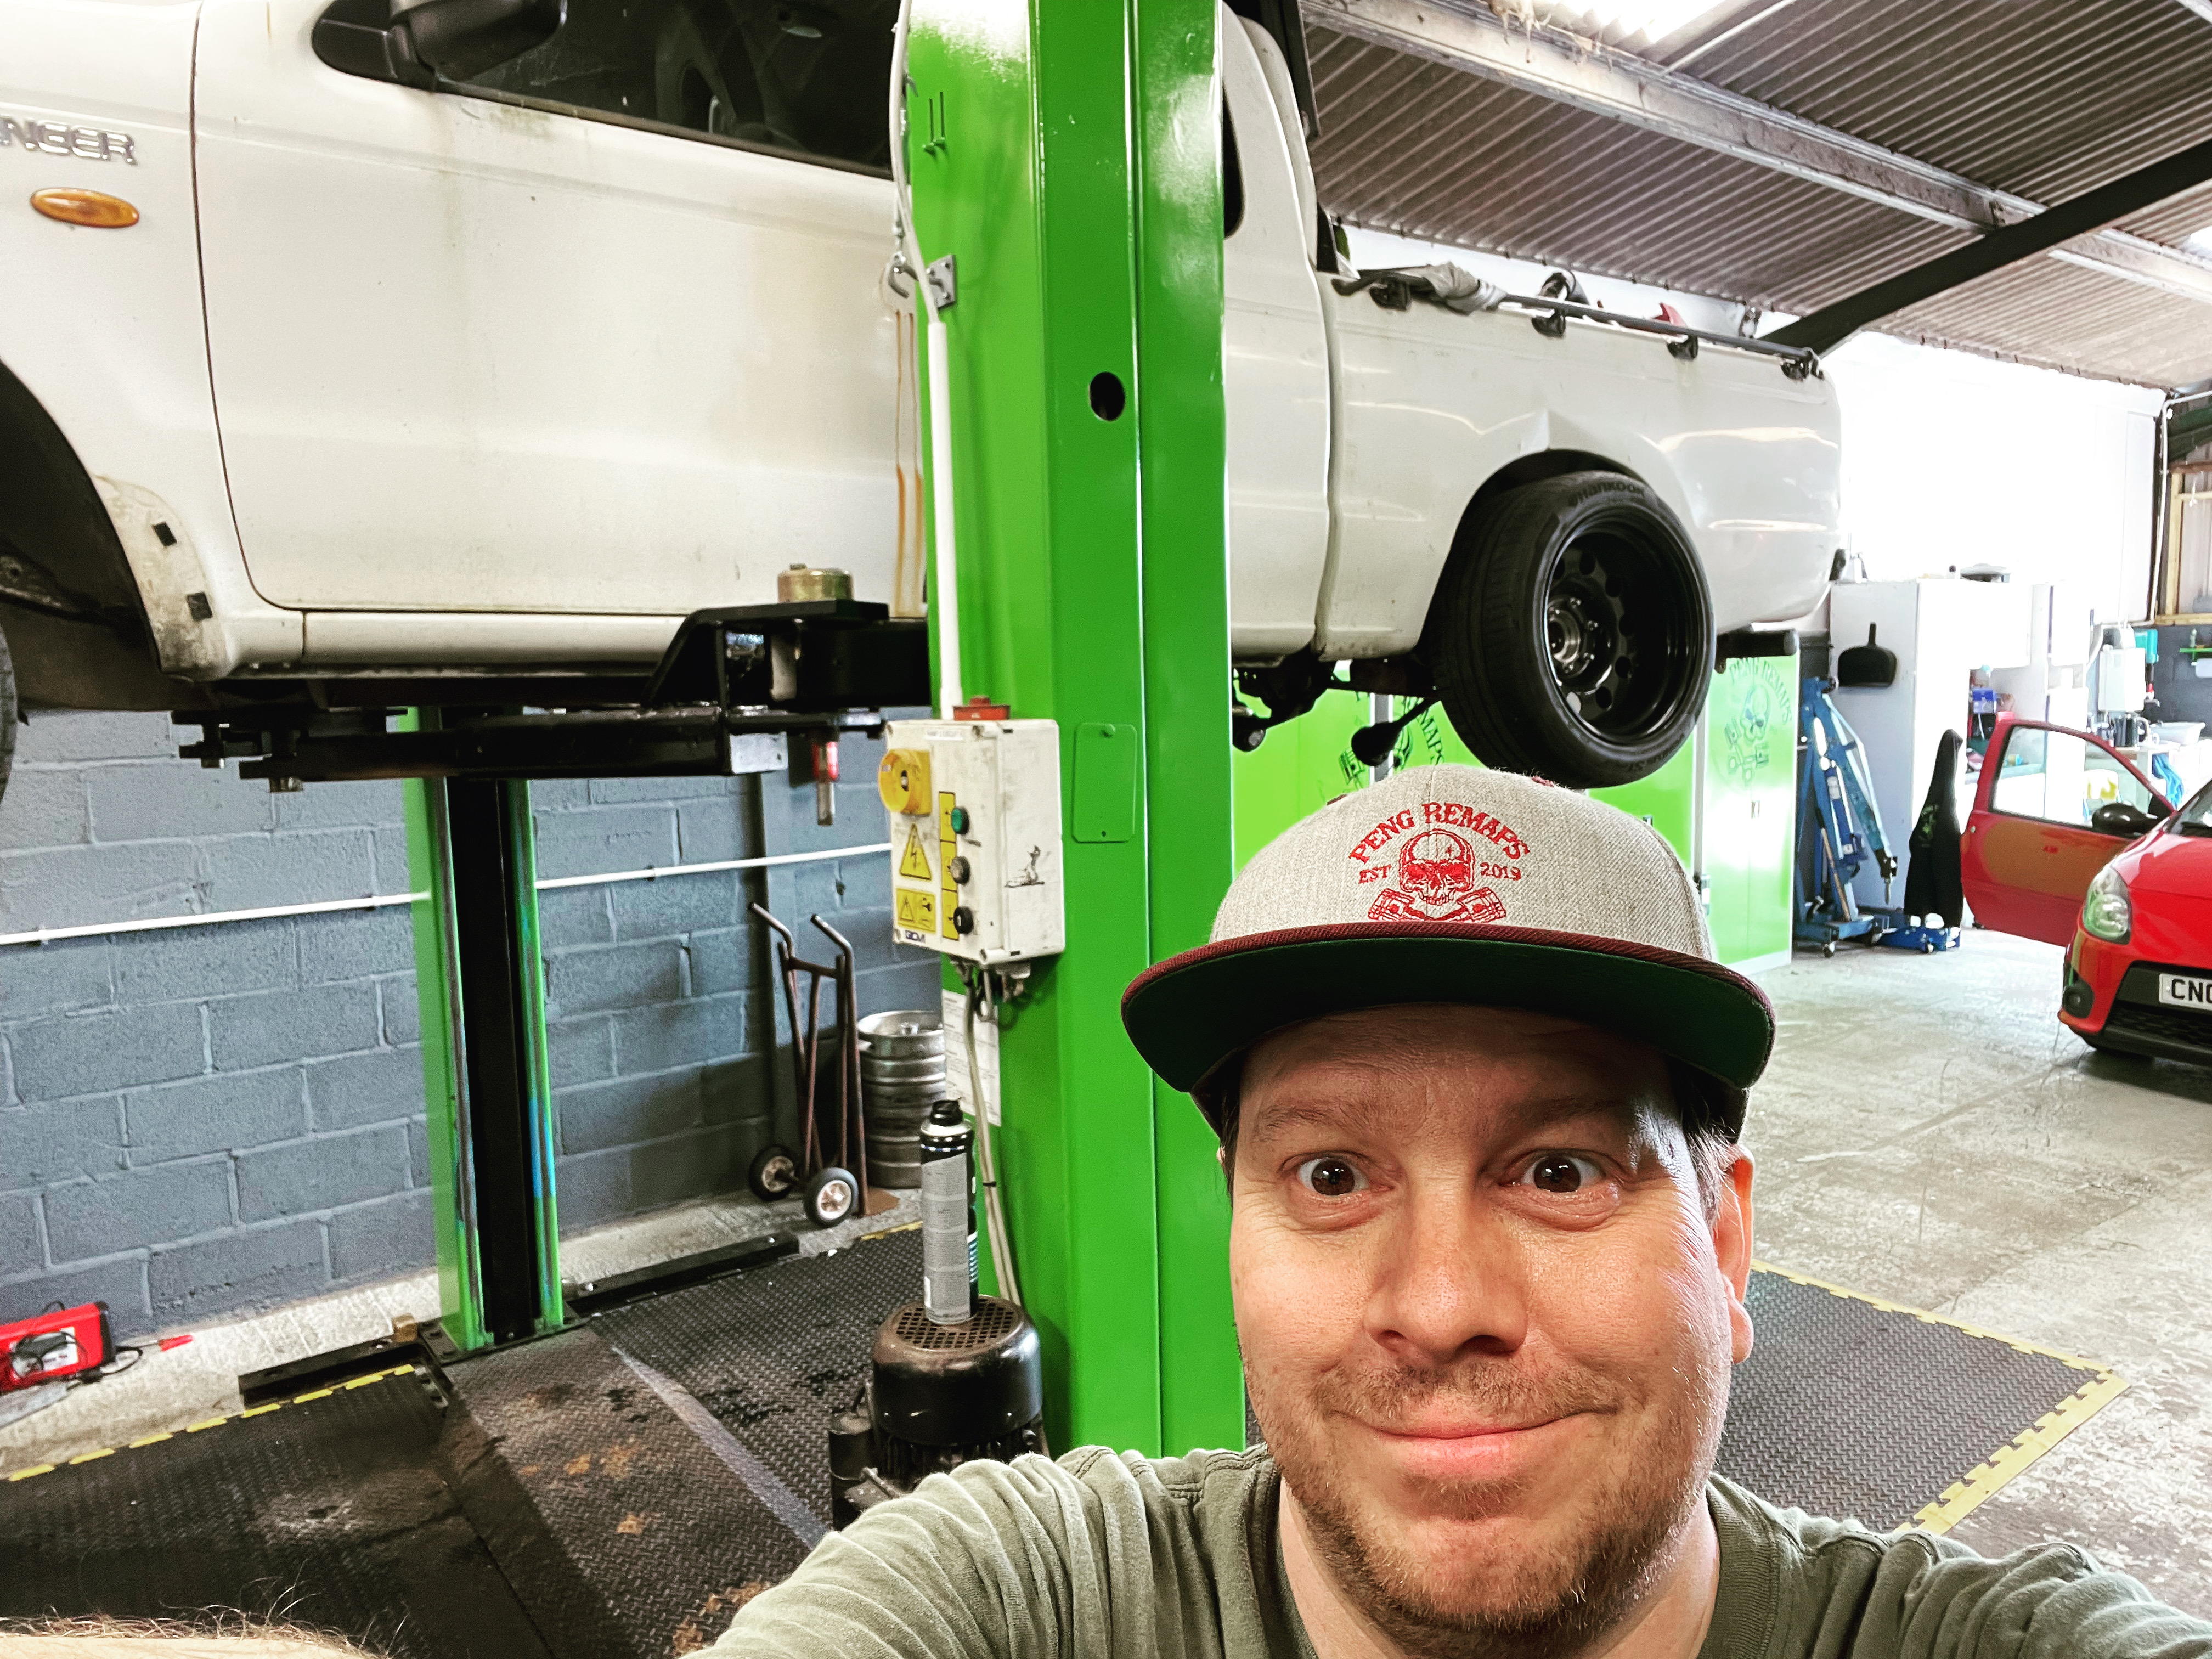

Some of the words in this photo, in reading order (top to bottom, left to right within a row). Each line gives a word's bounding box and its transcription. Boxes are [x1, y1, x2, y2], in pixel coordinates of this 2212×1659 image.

[1348, 809, 1415, 864] PENG
[1421, 802, 1530, 859] REMAPS
[1358, 864, 1391, 884] EST
[1480, 862, 1521, 881] 2019
